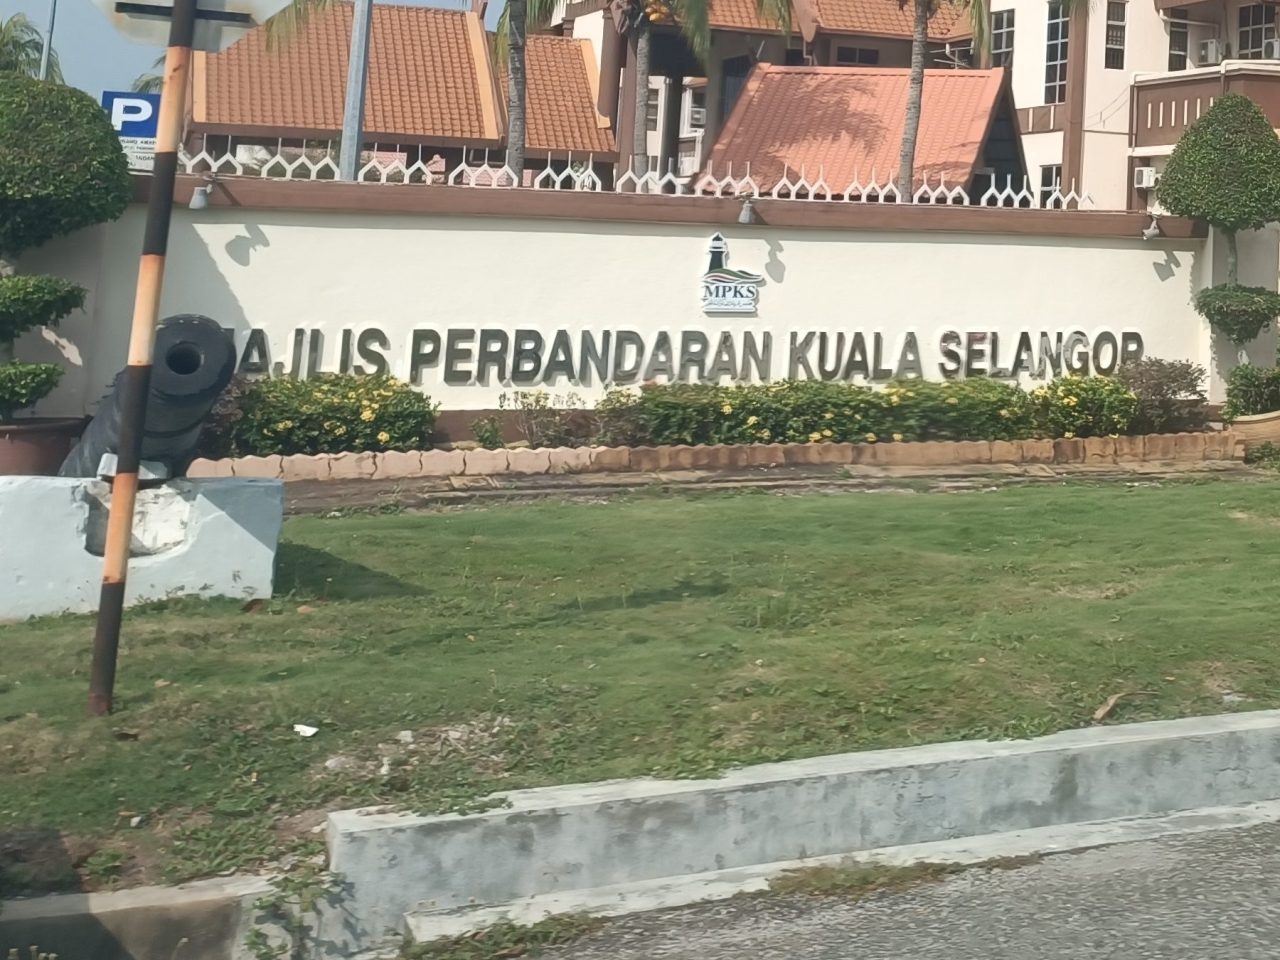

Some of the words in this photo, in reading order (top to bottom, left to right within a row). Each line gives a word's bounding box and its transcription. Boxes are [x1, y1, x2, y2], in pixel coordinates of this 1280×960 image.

[111, 97, 153, 131] P
[703, 285, 756, 299] MPKS
[222, 327, 391, 378] AJLIS
[409, 327, 774, 386] PERBANDARAN
[788, 330, 924, 380] KUALA
[937, 329, 1145, 380] SELANGOR
